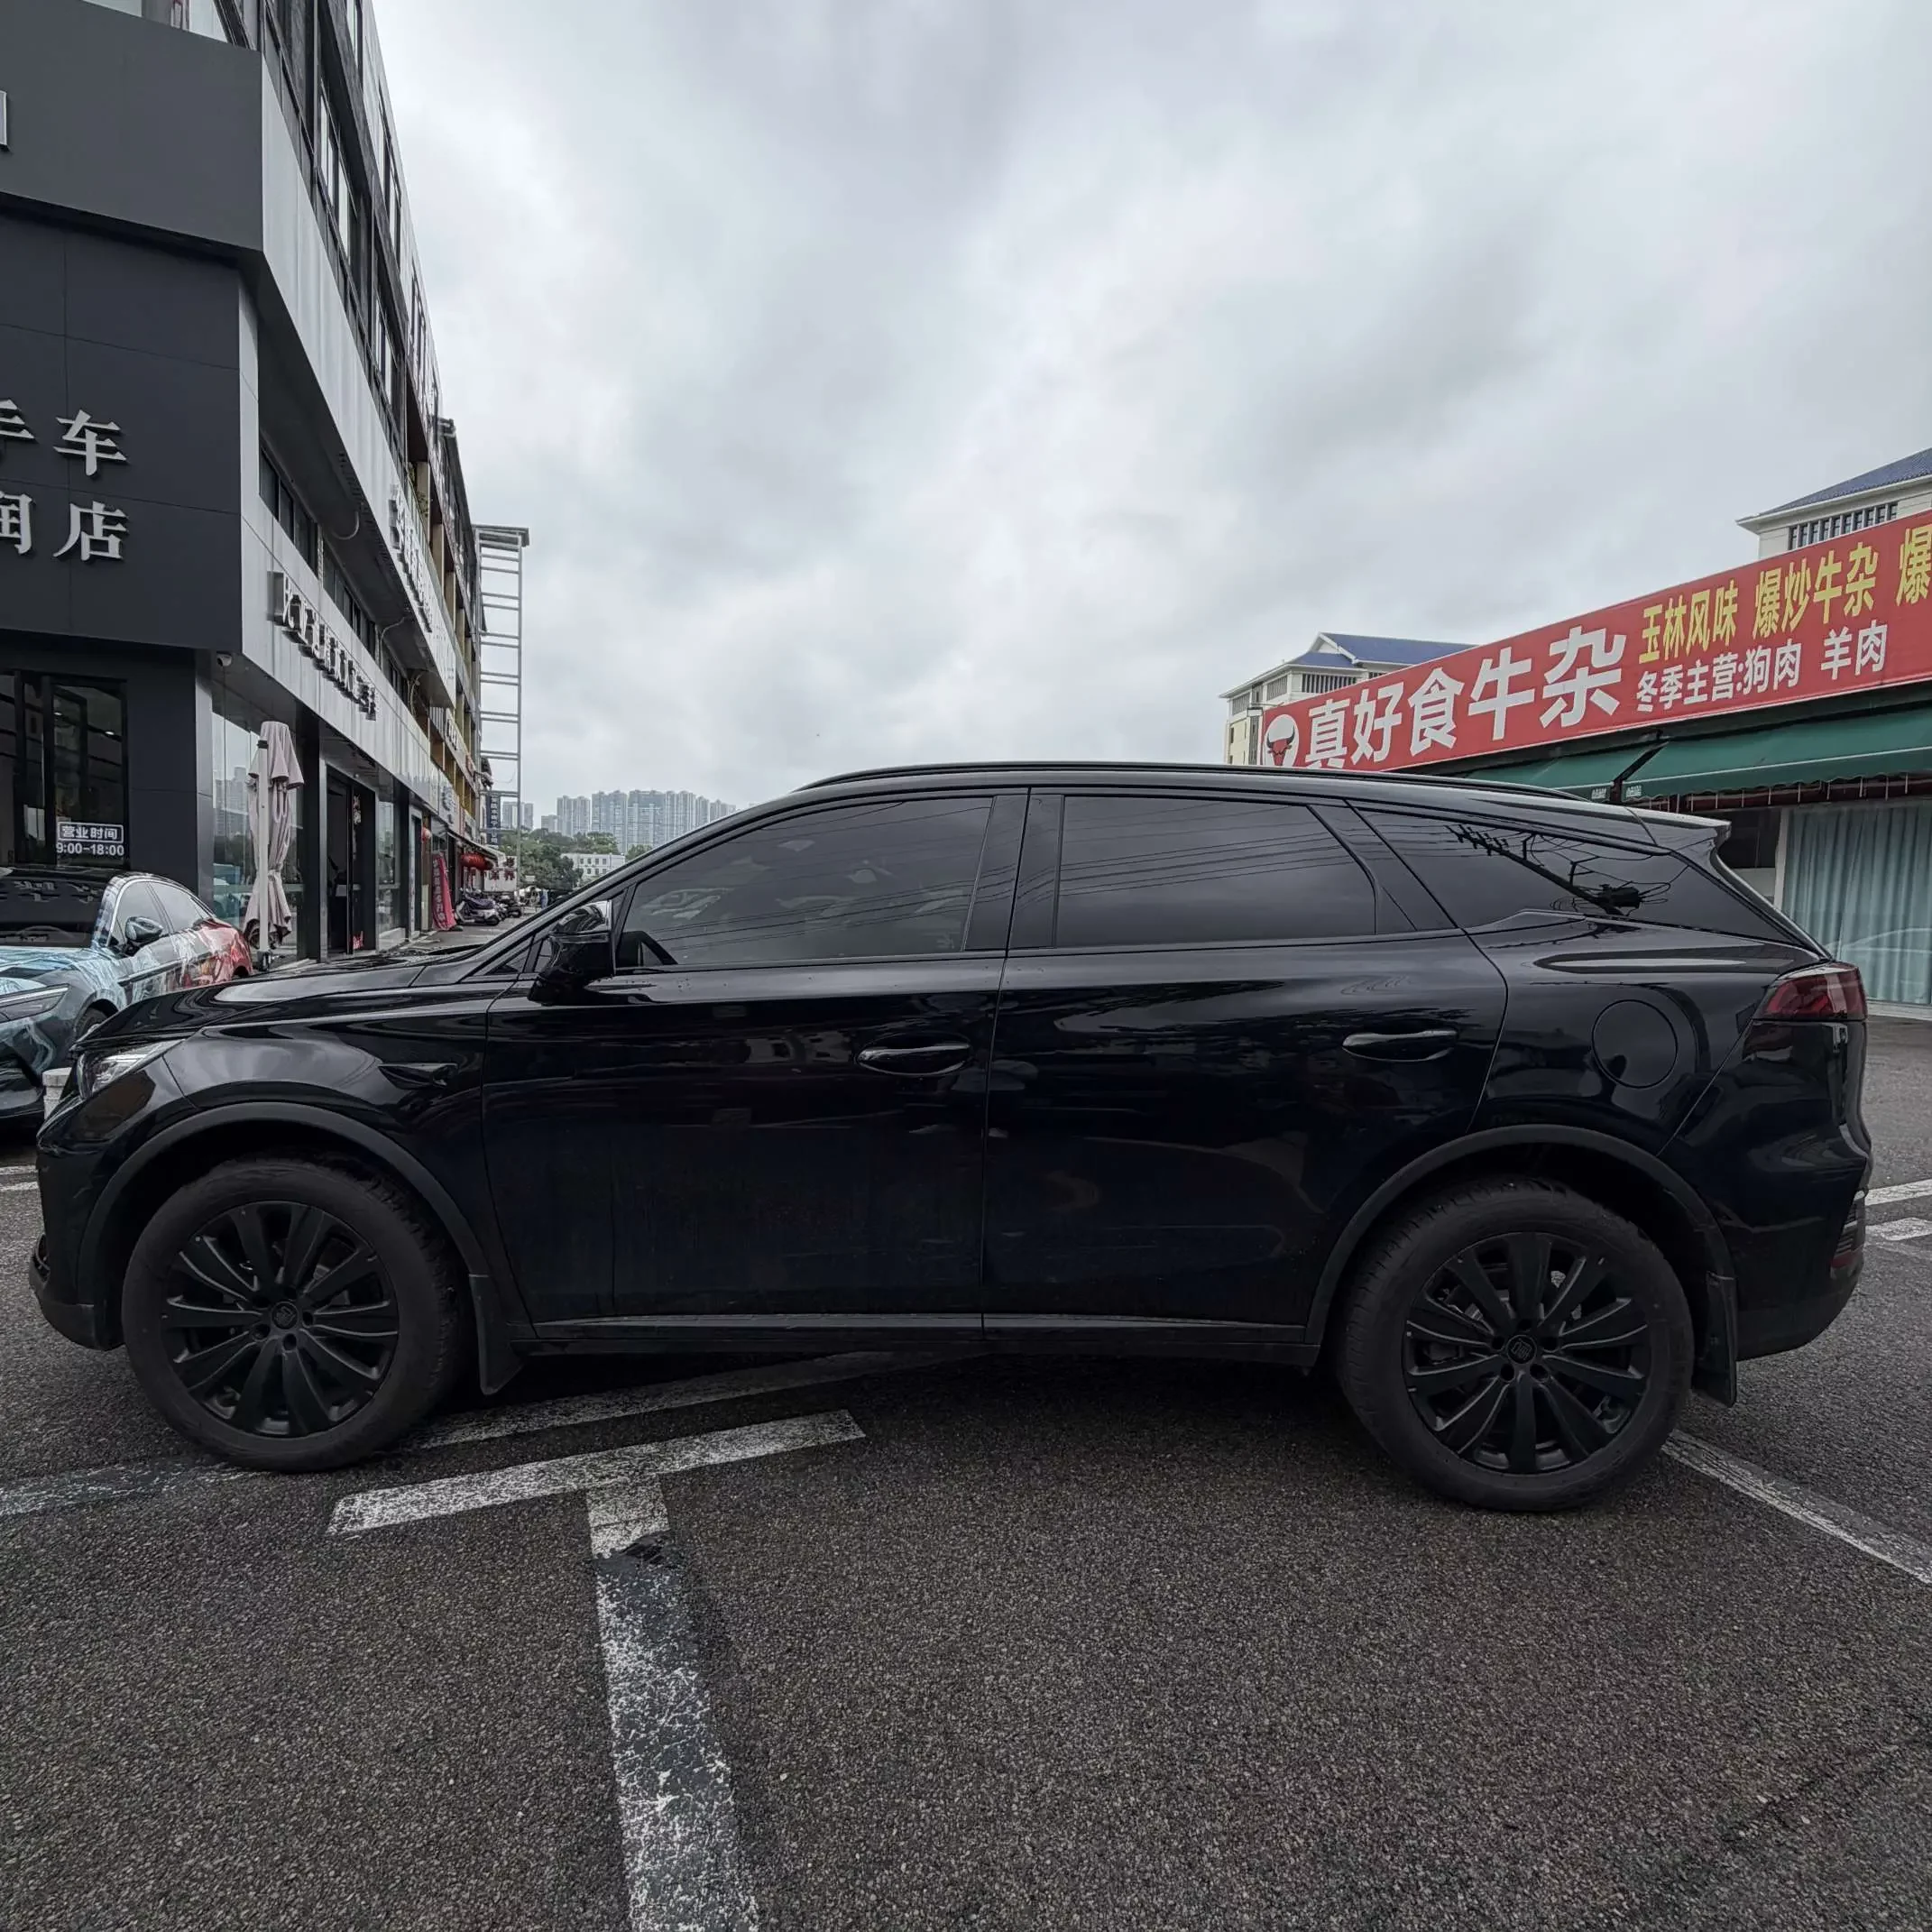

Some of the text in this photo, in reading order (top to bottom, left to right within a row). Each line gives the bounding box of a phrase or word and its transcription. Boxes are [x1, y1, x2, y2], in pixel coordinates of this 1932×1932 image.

[1638, 579, 1739, 665] 玉林风味
[1752, 541, 1879, 639] 爆炒牛杂
[1820, 619, 1888, 680] 羊肉
[1304, 625, 1627, 769] 真好食牛杂
[60, 825, 118, 840] 营业时间
